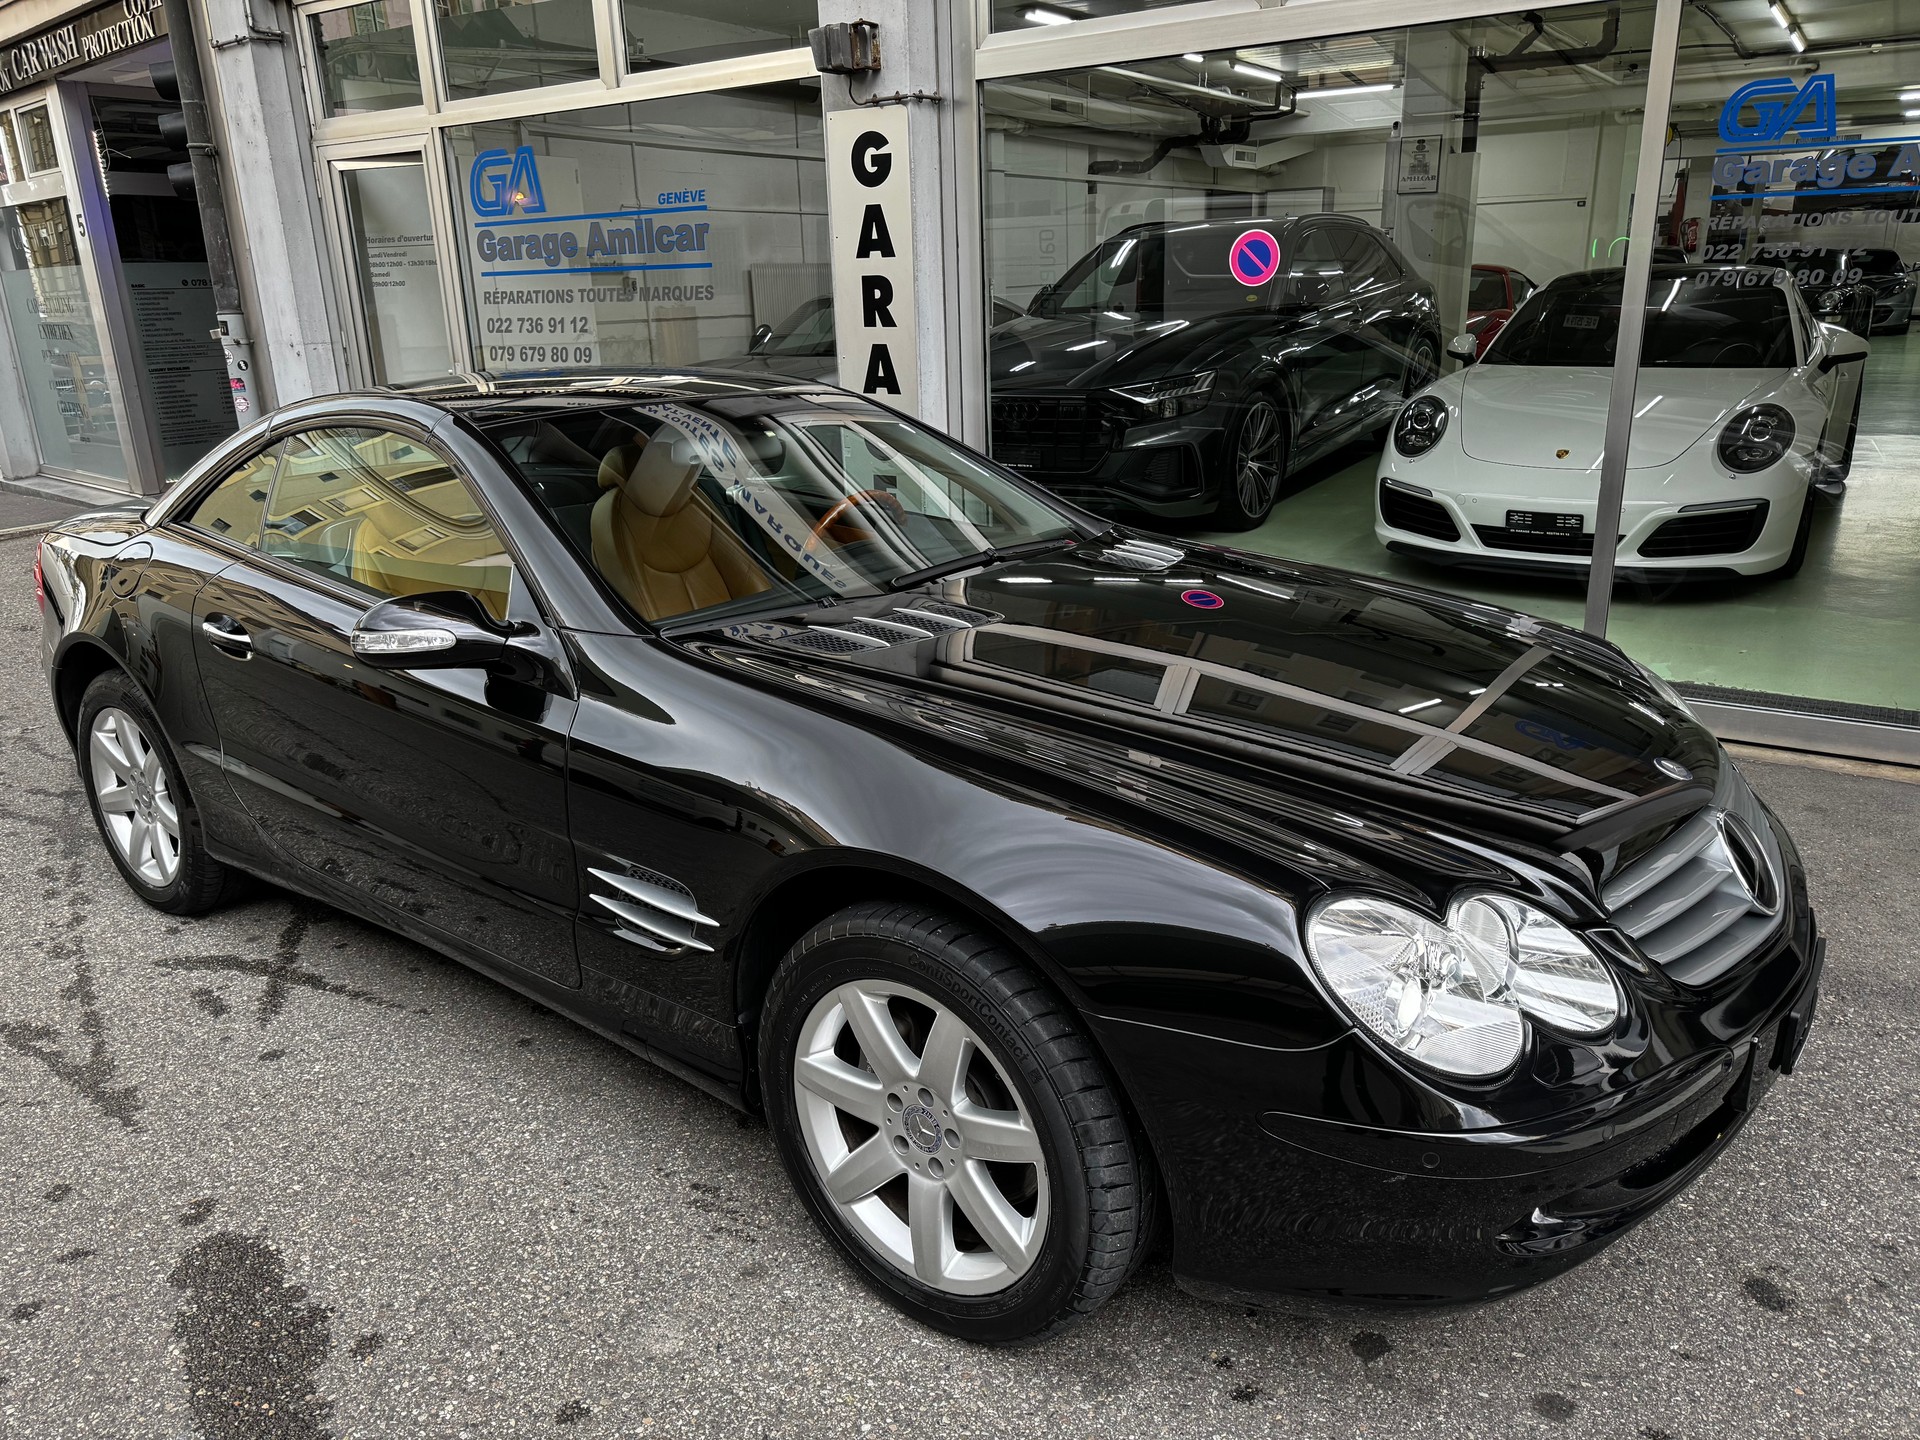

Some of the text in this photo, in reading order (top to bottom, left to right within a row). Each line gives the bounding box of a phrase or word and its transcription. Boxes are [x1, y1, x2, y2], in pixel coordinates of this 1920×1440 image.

[81, 11, 156, 61] PROTECTION
[11, 24, 79, 80] CAR WASH
[1712, 153, 1877, 189] Garage
[658, 188, 706, 205] GENÈVE
[76, 214, 86, 237] 5
[1707, 211, 1852, 231] RÉPARATIONS
[366, 236, 396, 244] Horaires
[477, 218, 710, 267] Garage Amilcar
[1702, 244, 1743, 260] 022
[1694, 268, 1863, 289] 079 679 80 09
[483, 284, 714, 305] RÉPARATIONS TOUTES MARQUES
[486, 316, 588, 333] 022 736 91 12
[490, 346, 592, 363] 079 679 80 09
[908, 952, 1029, 1063] ContiSportContact
